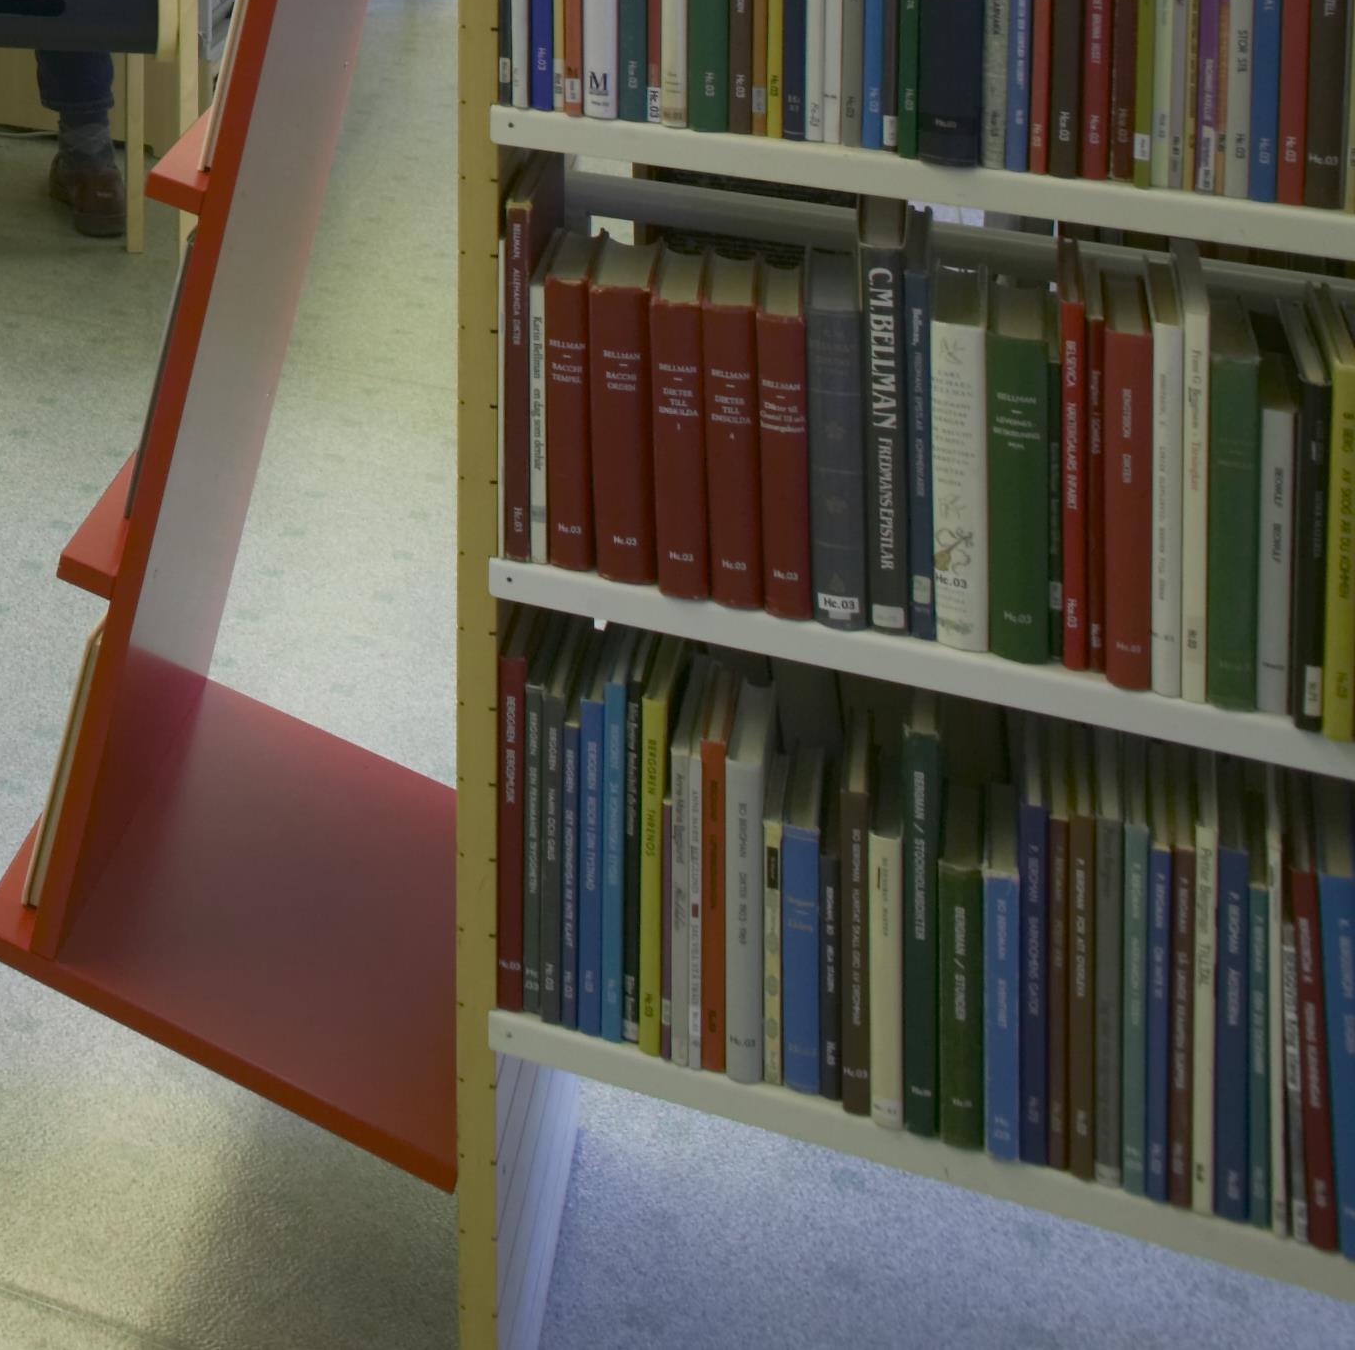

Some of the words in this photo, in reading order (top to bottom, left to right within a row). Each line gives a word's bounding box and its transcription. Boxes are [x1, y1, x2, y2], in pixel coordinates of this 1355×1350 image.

[648, 90, 660, 119] Hc.03
[533, 316, 543, 340] Karin
[549, 339, 586, 350] BELLMAN
[603, 350, 641, 361] BELLMAN
[867, 267, 897, 430] C.M.BELLMAN
[533, 343, 543, 378] Bellman
[659, 362, 697, 374] BELLMAN
[711, 369, 750, 381] BELLMAN
[762, 378, 801, 391] BELLMAN
[534, 388, 541, 399] en
[531, 401, 542, 416] dag
[533, 439, 543, 470] denhär
[513, 507, 524, 532] Hc.03
[936, 574, 967, 589] Hc.03
[823, 596, 855, 609] Hc.03
[1004, 610, 1032, 625] Hc.03
[506, 696, 516, 742] BERGGREN
[646, 739, 658, 794] BERGGREN
[913, 771, 925, 819] BERGMAN
[645, 809, 656, 857] THRENOS
[954, 907, 966, 955] BERGMAN
[954, 974, 966, 1021] STUNDER
